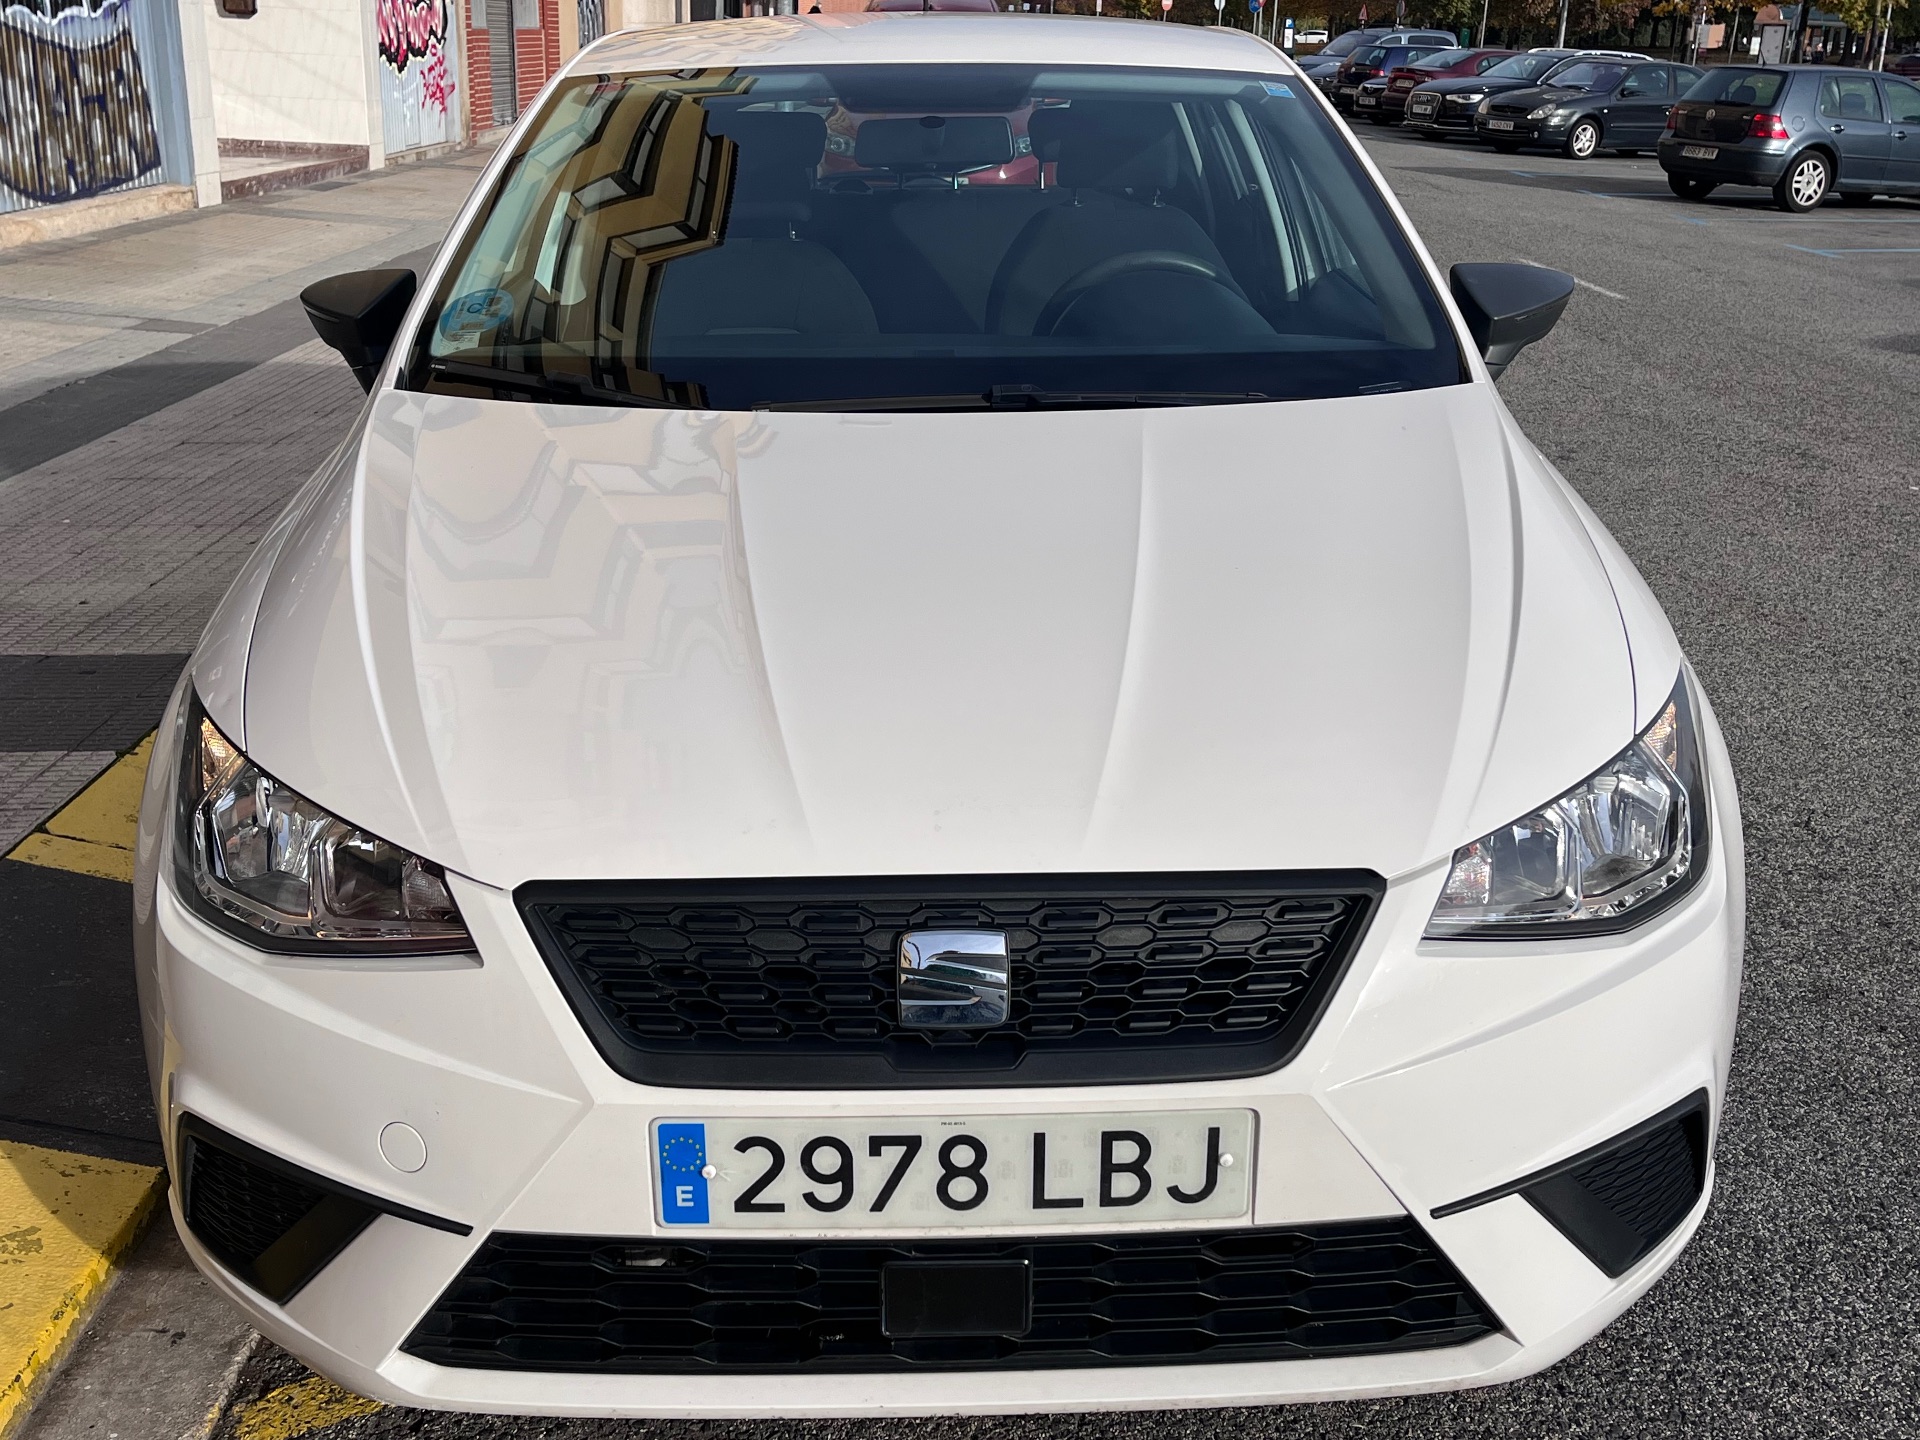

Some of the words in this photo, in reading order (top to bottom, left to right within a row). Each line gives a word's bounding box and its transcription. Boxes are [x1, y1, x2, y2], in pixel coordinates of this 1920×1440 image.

[1286, 19, 1293, 28] P
[733, 1134, 989, 1213] 2978
[1032, 1126, 1221, 1210] LBJ
[676, 1185, 694, 1207] E
